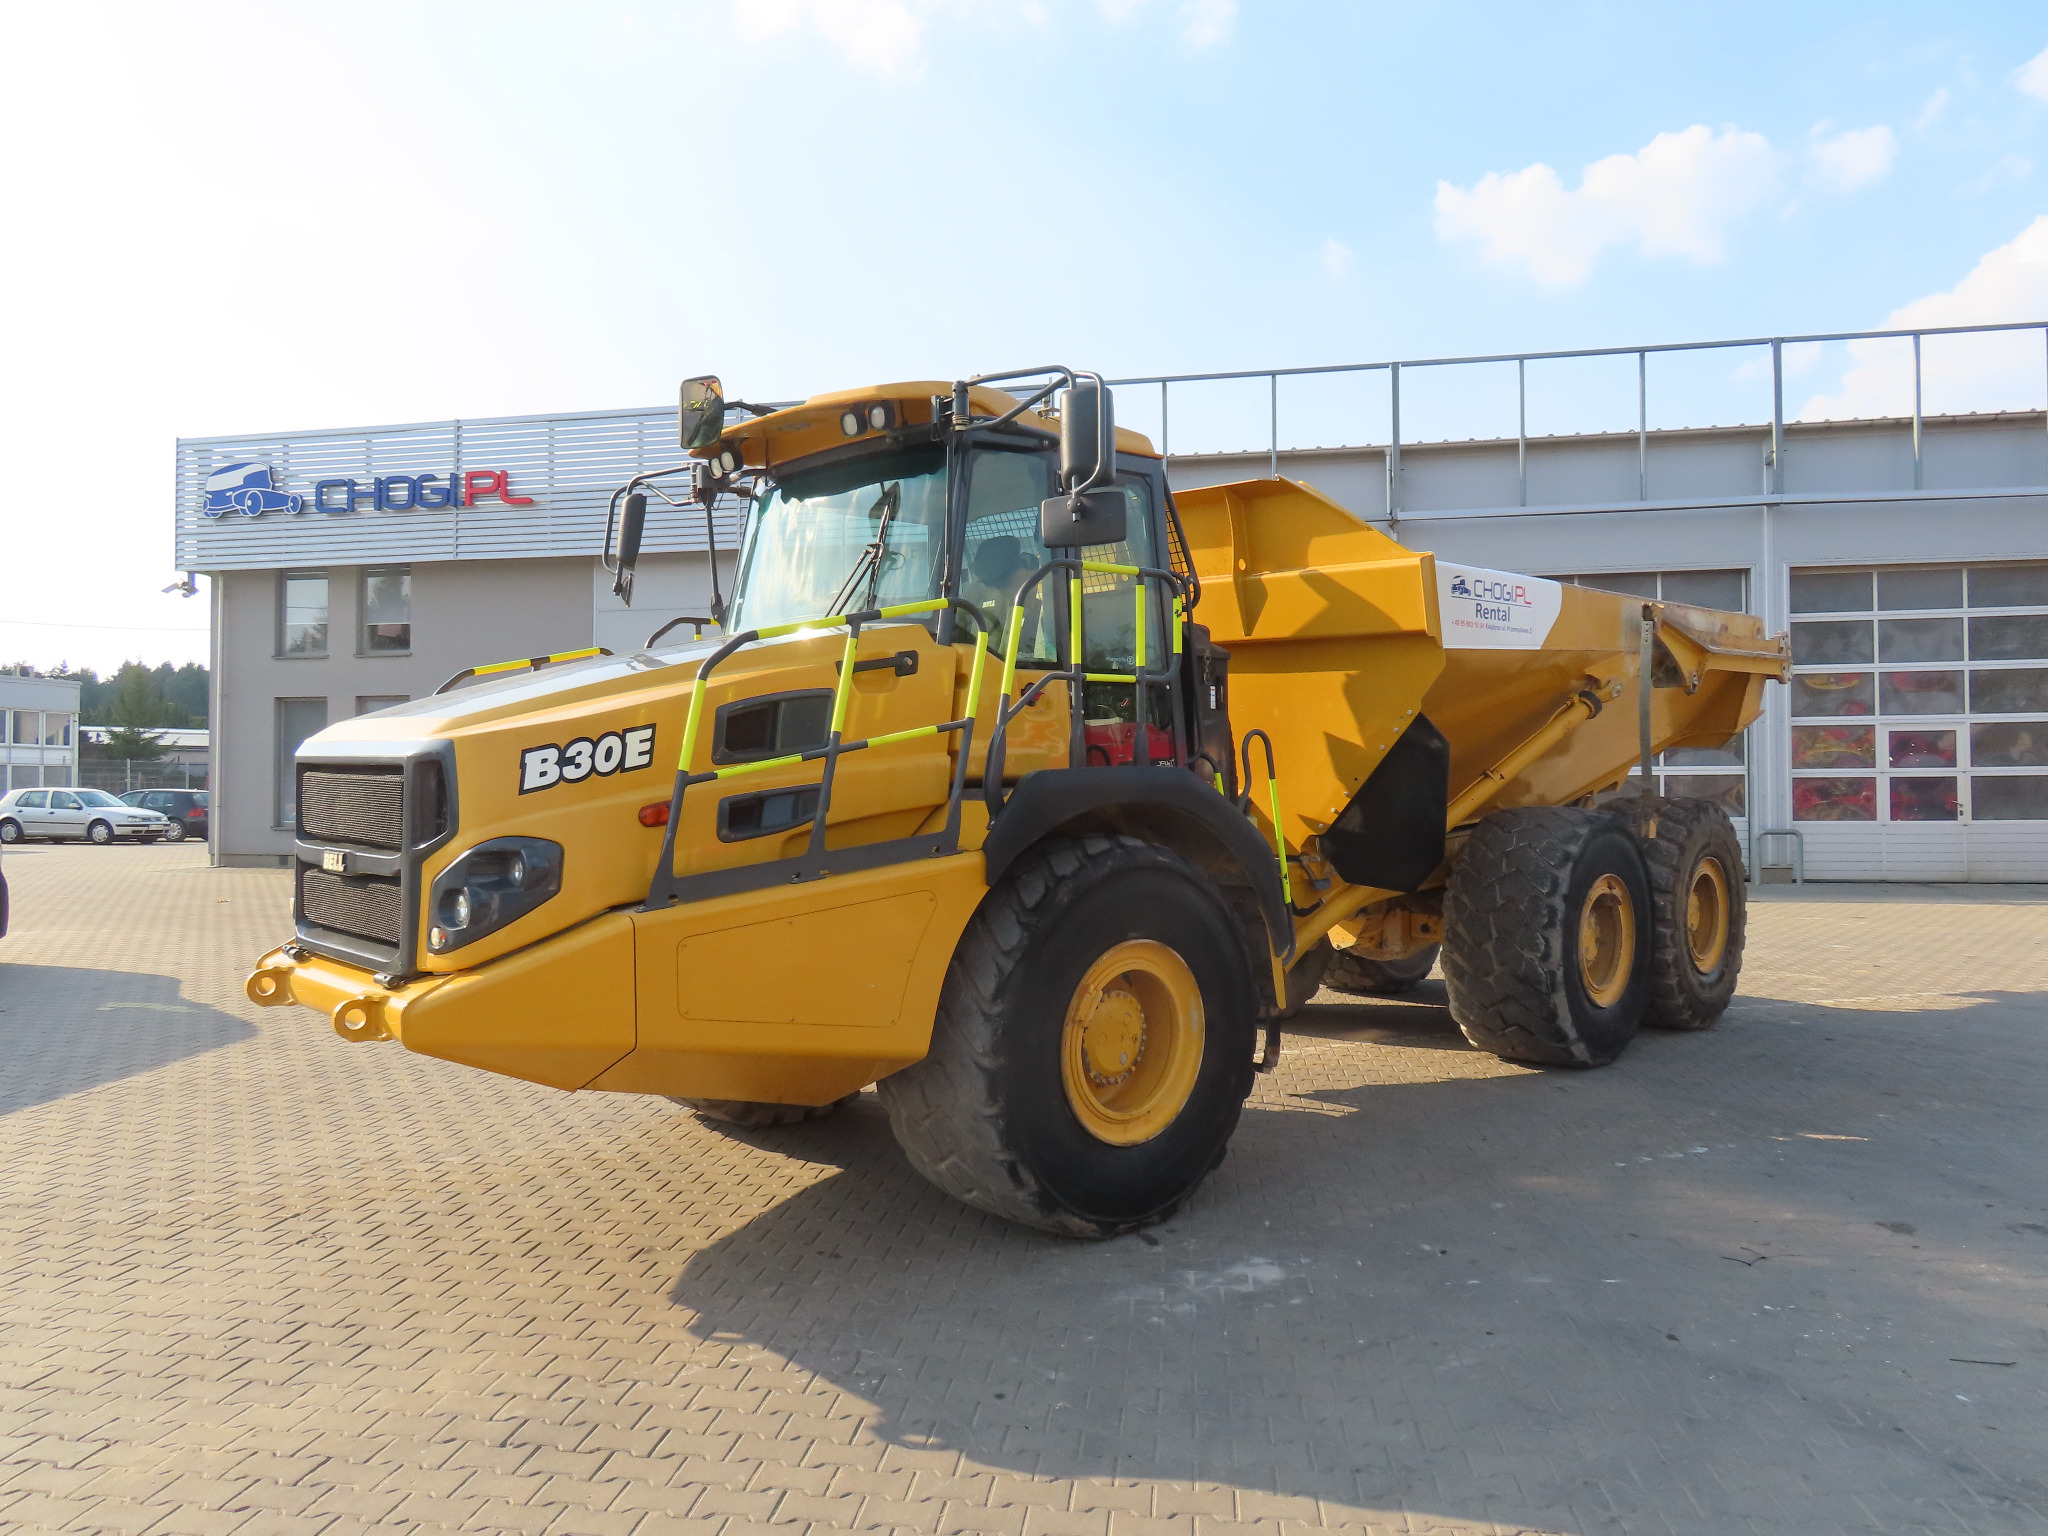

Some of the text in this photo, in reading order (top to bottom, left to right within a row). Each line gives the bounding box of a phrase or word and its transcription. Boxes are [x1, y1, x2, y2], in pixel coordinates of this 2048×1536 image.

[1475, 603, 1511, 622] Rental
[519, 724, 656, 795] B30E
[322, 850, 345, 872] BELL
